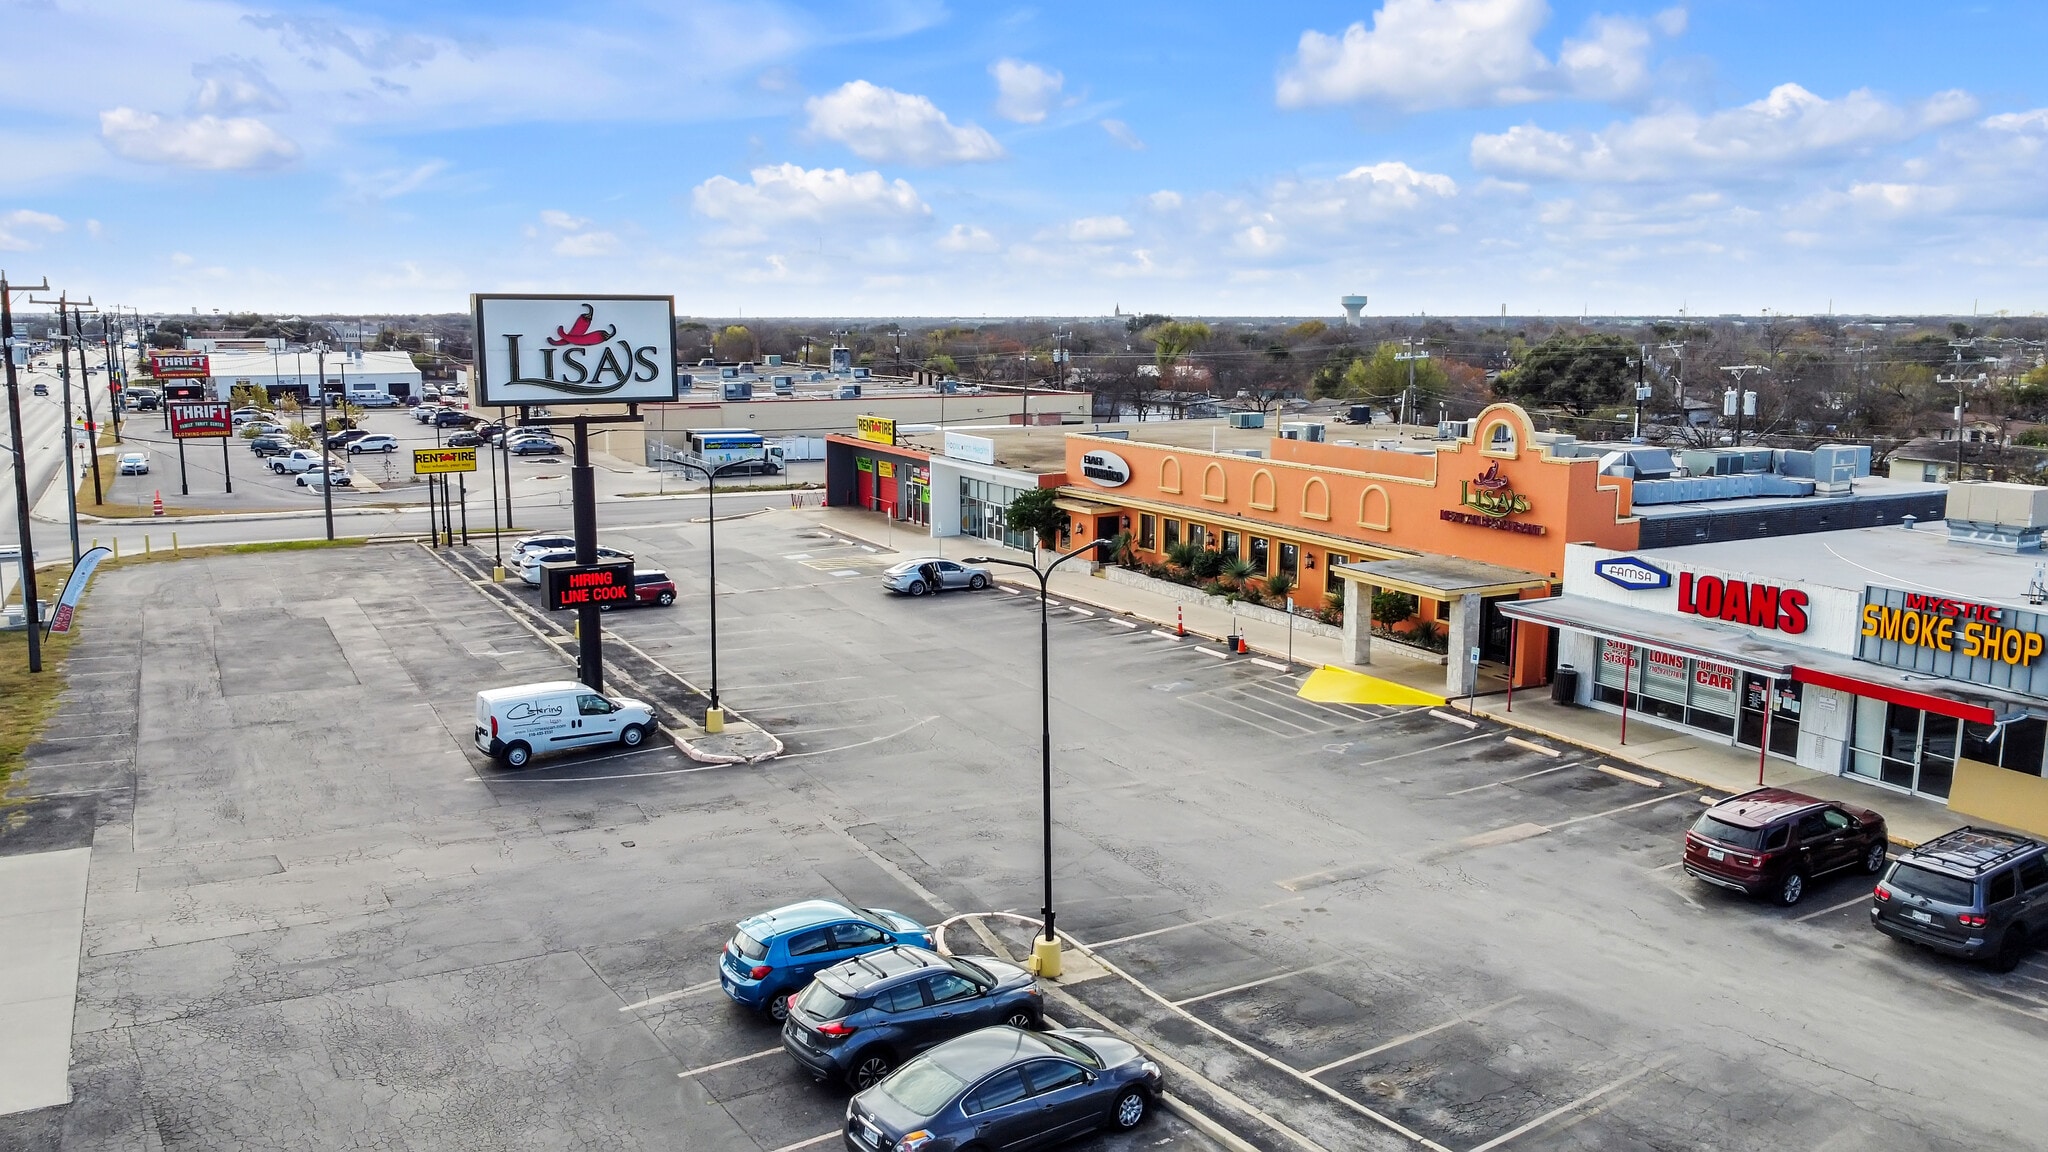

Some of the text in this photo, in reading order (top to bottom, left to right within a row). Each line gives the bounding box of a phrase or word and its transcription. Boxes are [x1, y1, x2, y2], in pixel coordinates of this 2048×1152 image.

[155, 356, 206, 367] THRIFT
[173, 404, 228, 421] THRIFT
[858, 418, 892, 436] RENT TIRE
[415, 451, 476, 464] RENT TIRE
[1084, 455, 1104, 466] BAR
[1289, 545, 1294, 554] 2
[570, 571, 613, 588] HIRING
[1609, 565, 1652, 582] FAMSA
[561, 584, 627, 604] LINE COOK
[1678, 571, 1809, 635] LOANS
[54, 605, 67, 628] OPEN
[1905, 592, 2001, 624] MYSTIC
[1861, 603, 2045, 667] SMOKE SHOP
[1603, 652, 1635, 667] $1300
[1649, 649, 1684, 669] LOANS
[1696, 670, 1733, 690] CAR
[506, 700, 563, 722] Catering
